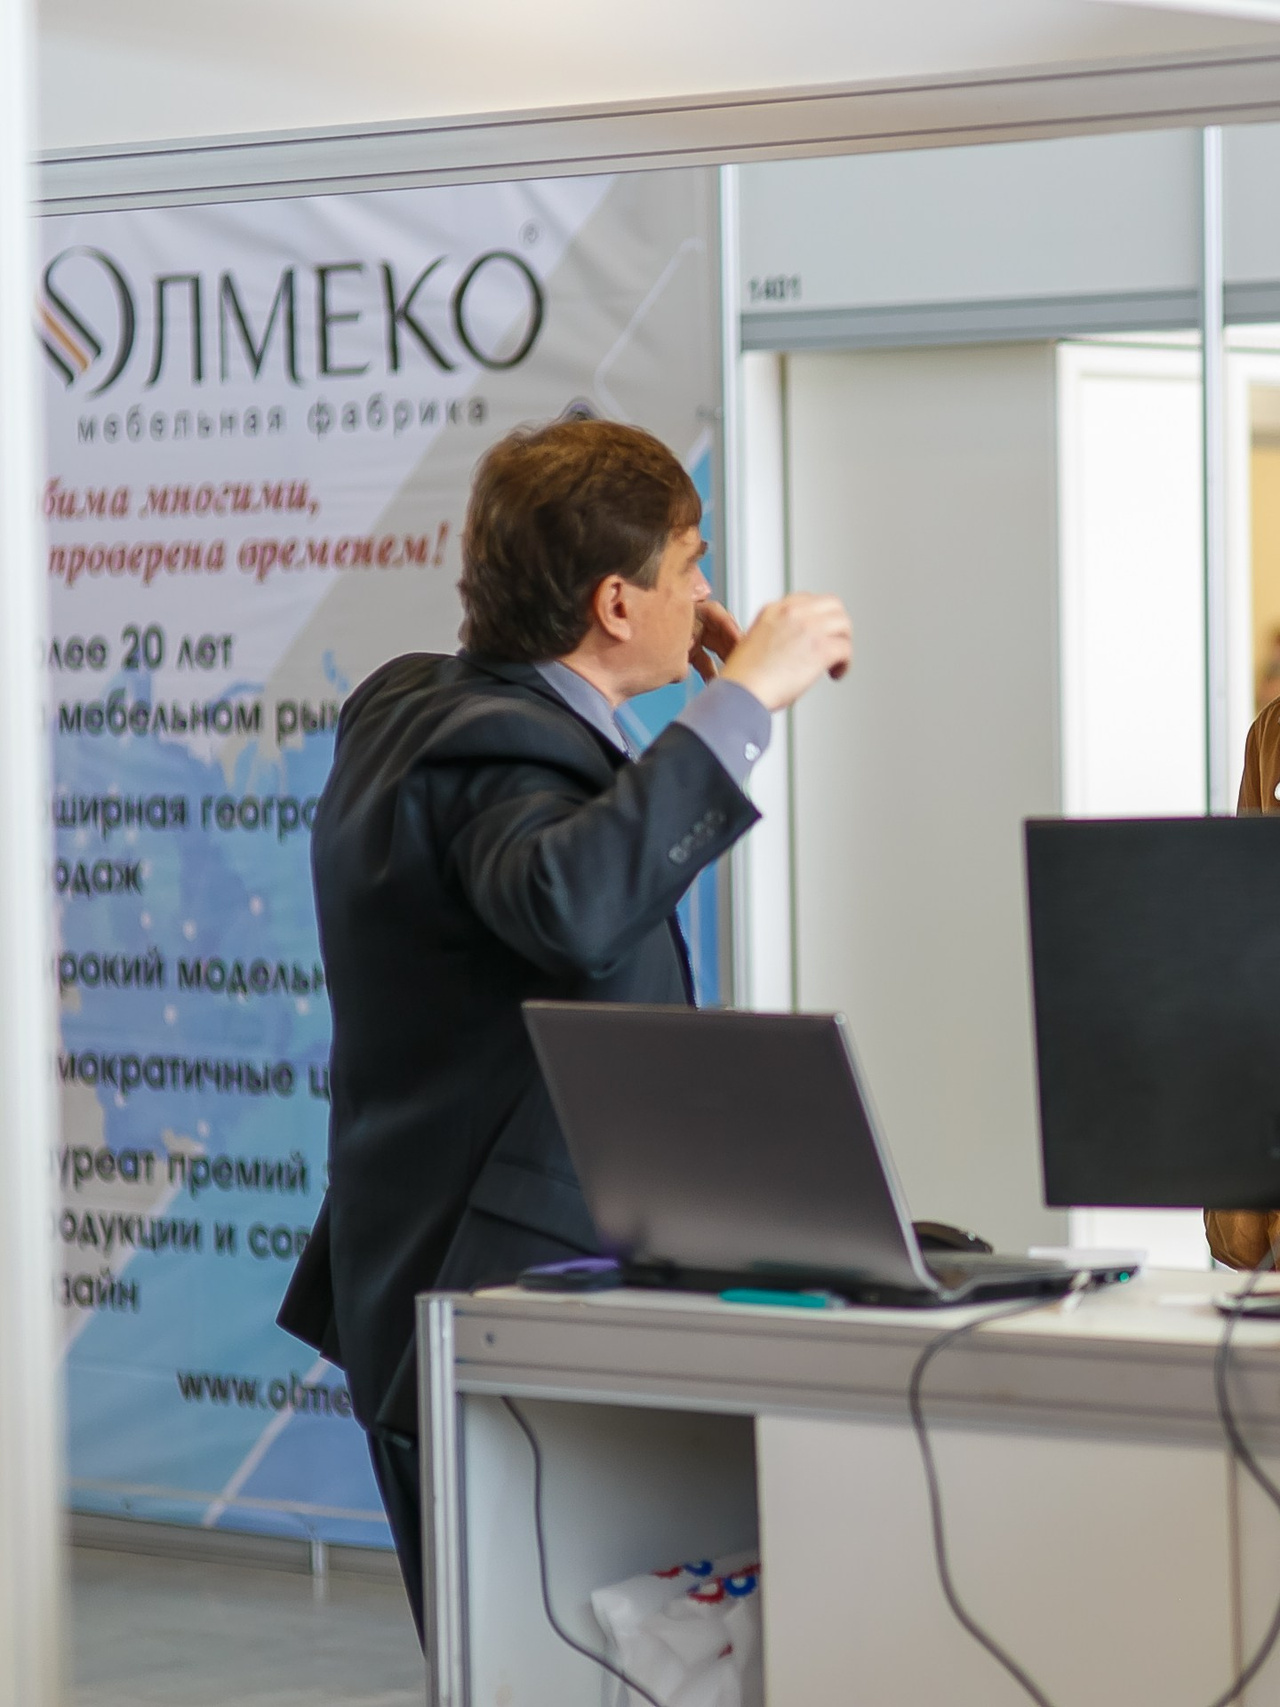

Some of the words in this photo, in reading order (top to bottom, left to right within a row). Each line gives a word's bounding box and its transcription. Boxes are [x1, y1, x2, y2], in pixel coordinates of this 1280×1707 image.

[77, 402, 284, 444] мебельная
[307, 395, 488, 440] фабрика
[121, 624, 164, 670] 20
[177, 633, 234, 668] лет
[58, 687, 261, 735] мебельном
[168, 1151, 307, 1199] премий
[213, 1221, 236, 1256] и
